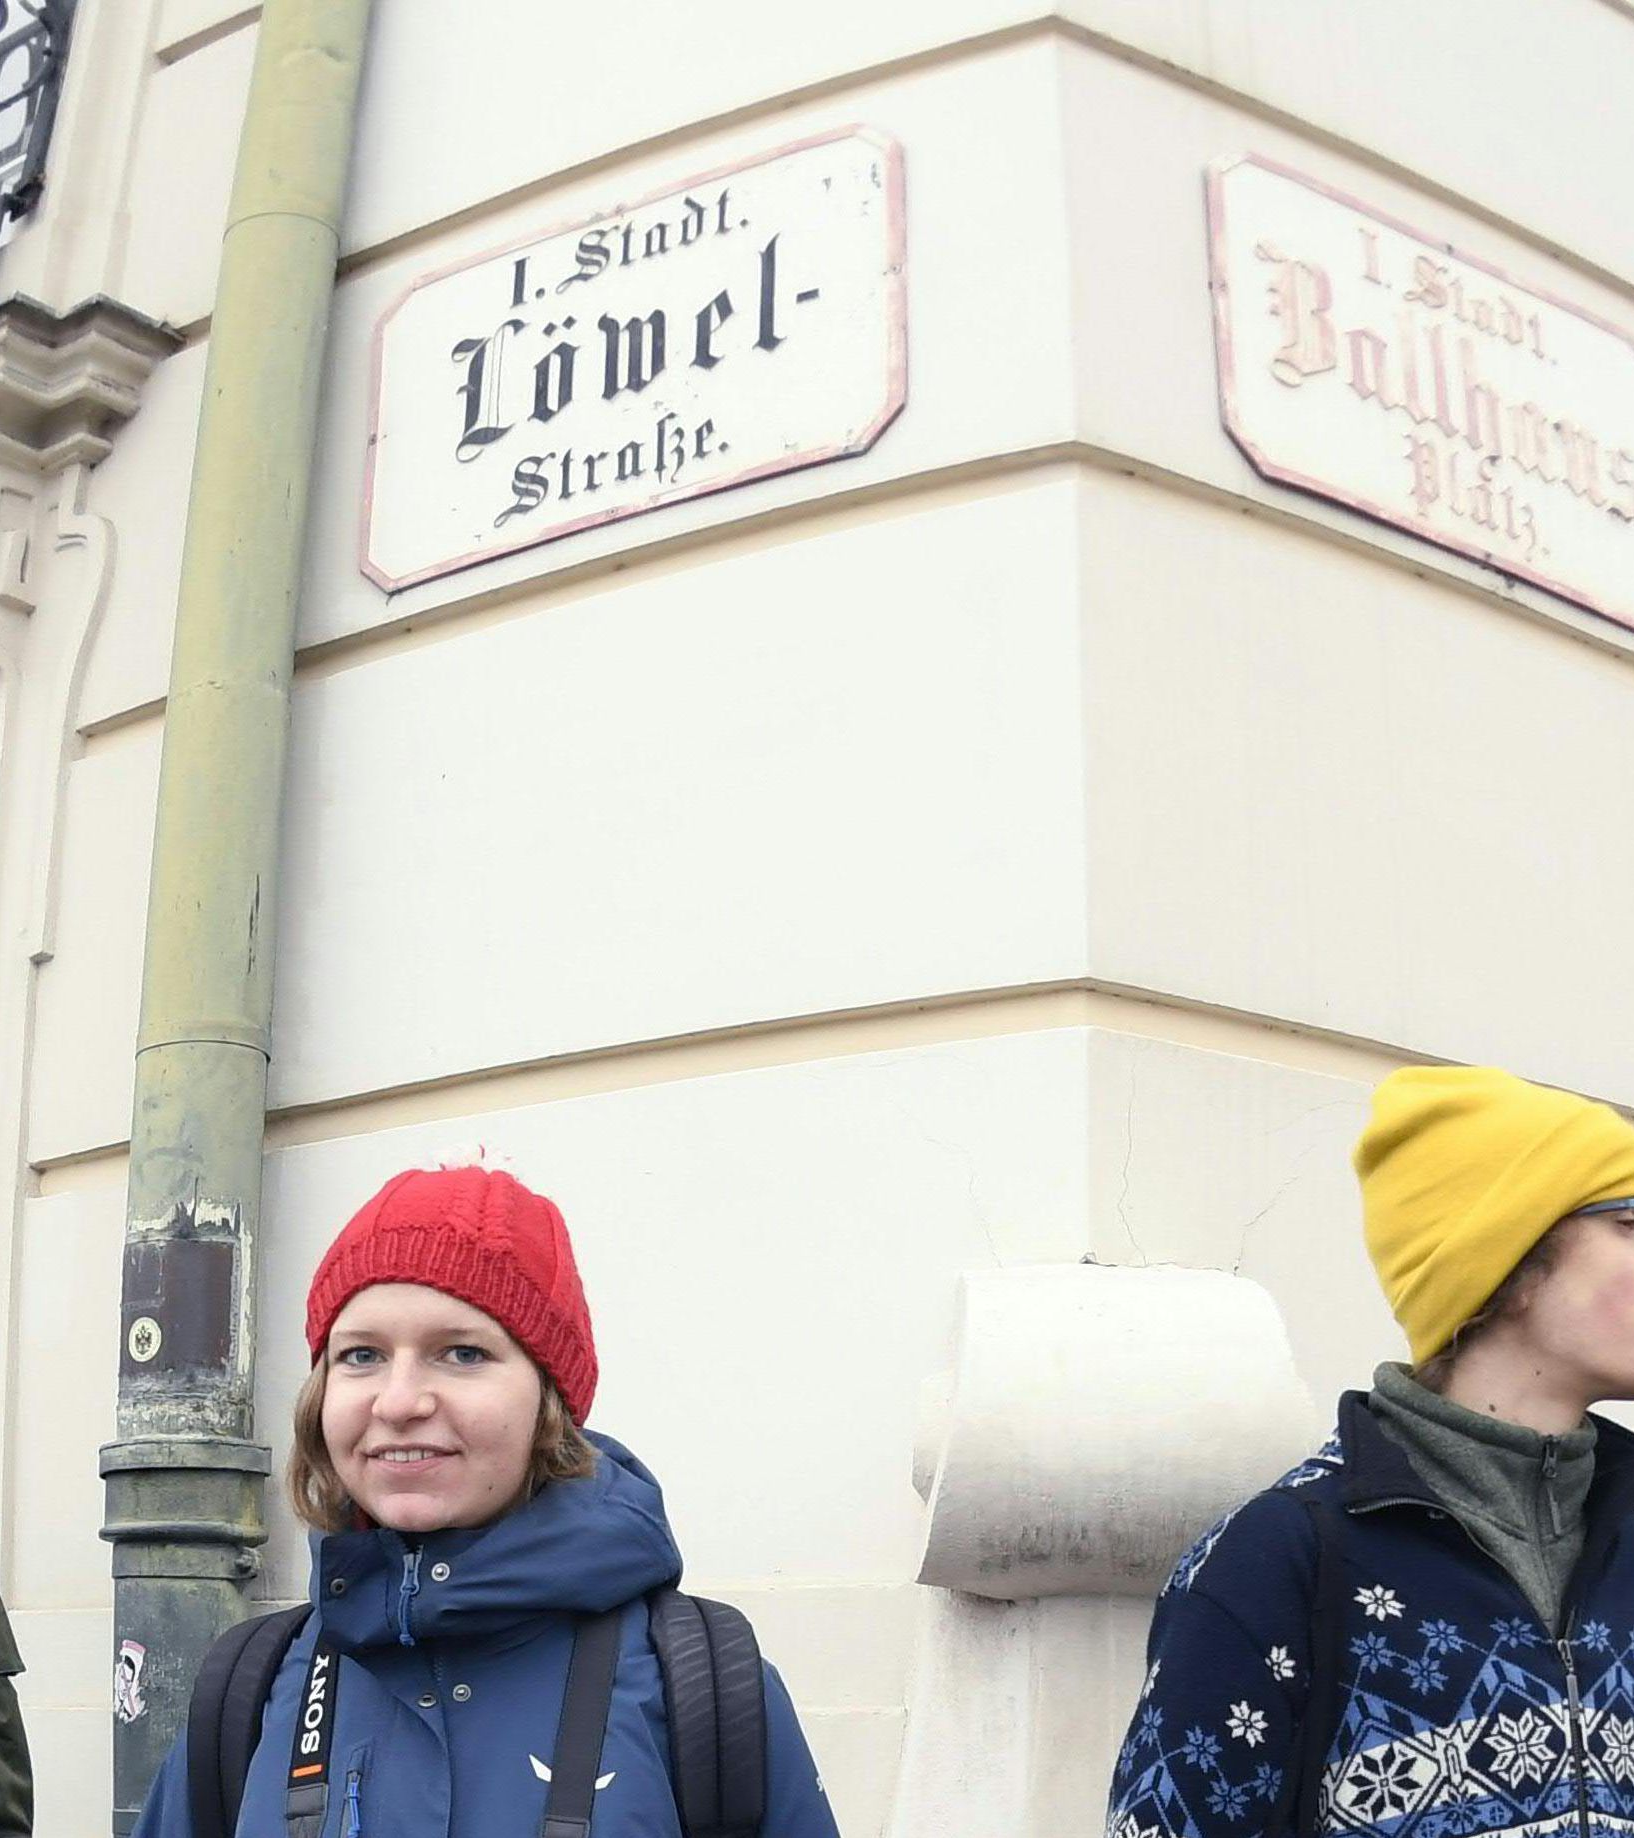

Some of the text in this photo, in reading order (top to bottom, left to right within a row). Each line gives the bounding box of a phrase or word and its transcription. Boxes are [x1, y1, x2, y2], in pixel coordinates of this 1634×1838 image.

[555, 188, 750, 294] Stadt.
[450, 233, 820, 464] Löwel-
[300, 1654, 330, 1755] SONY
